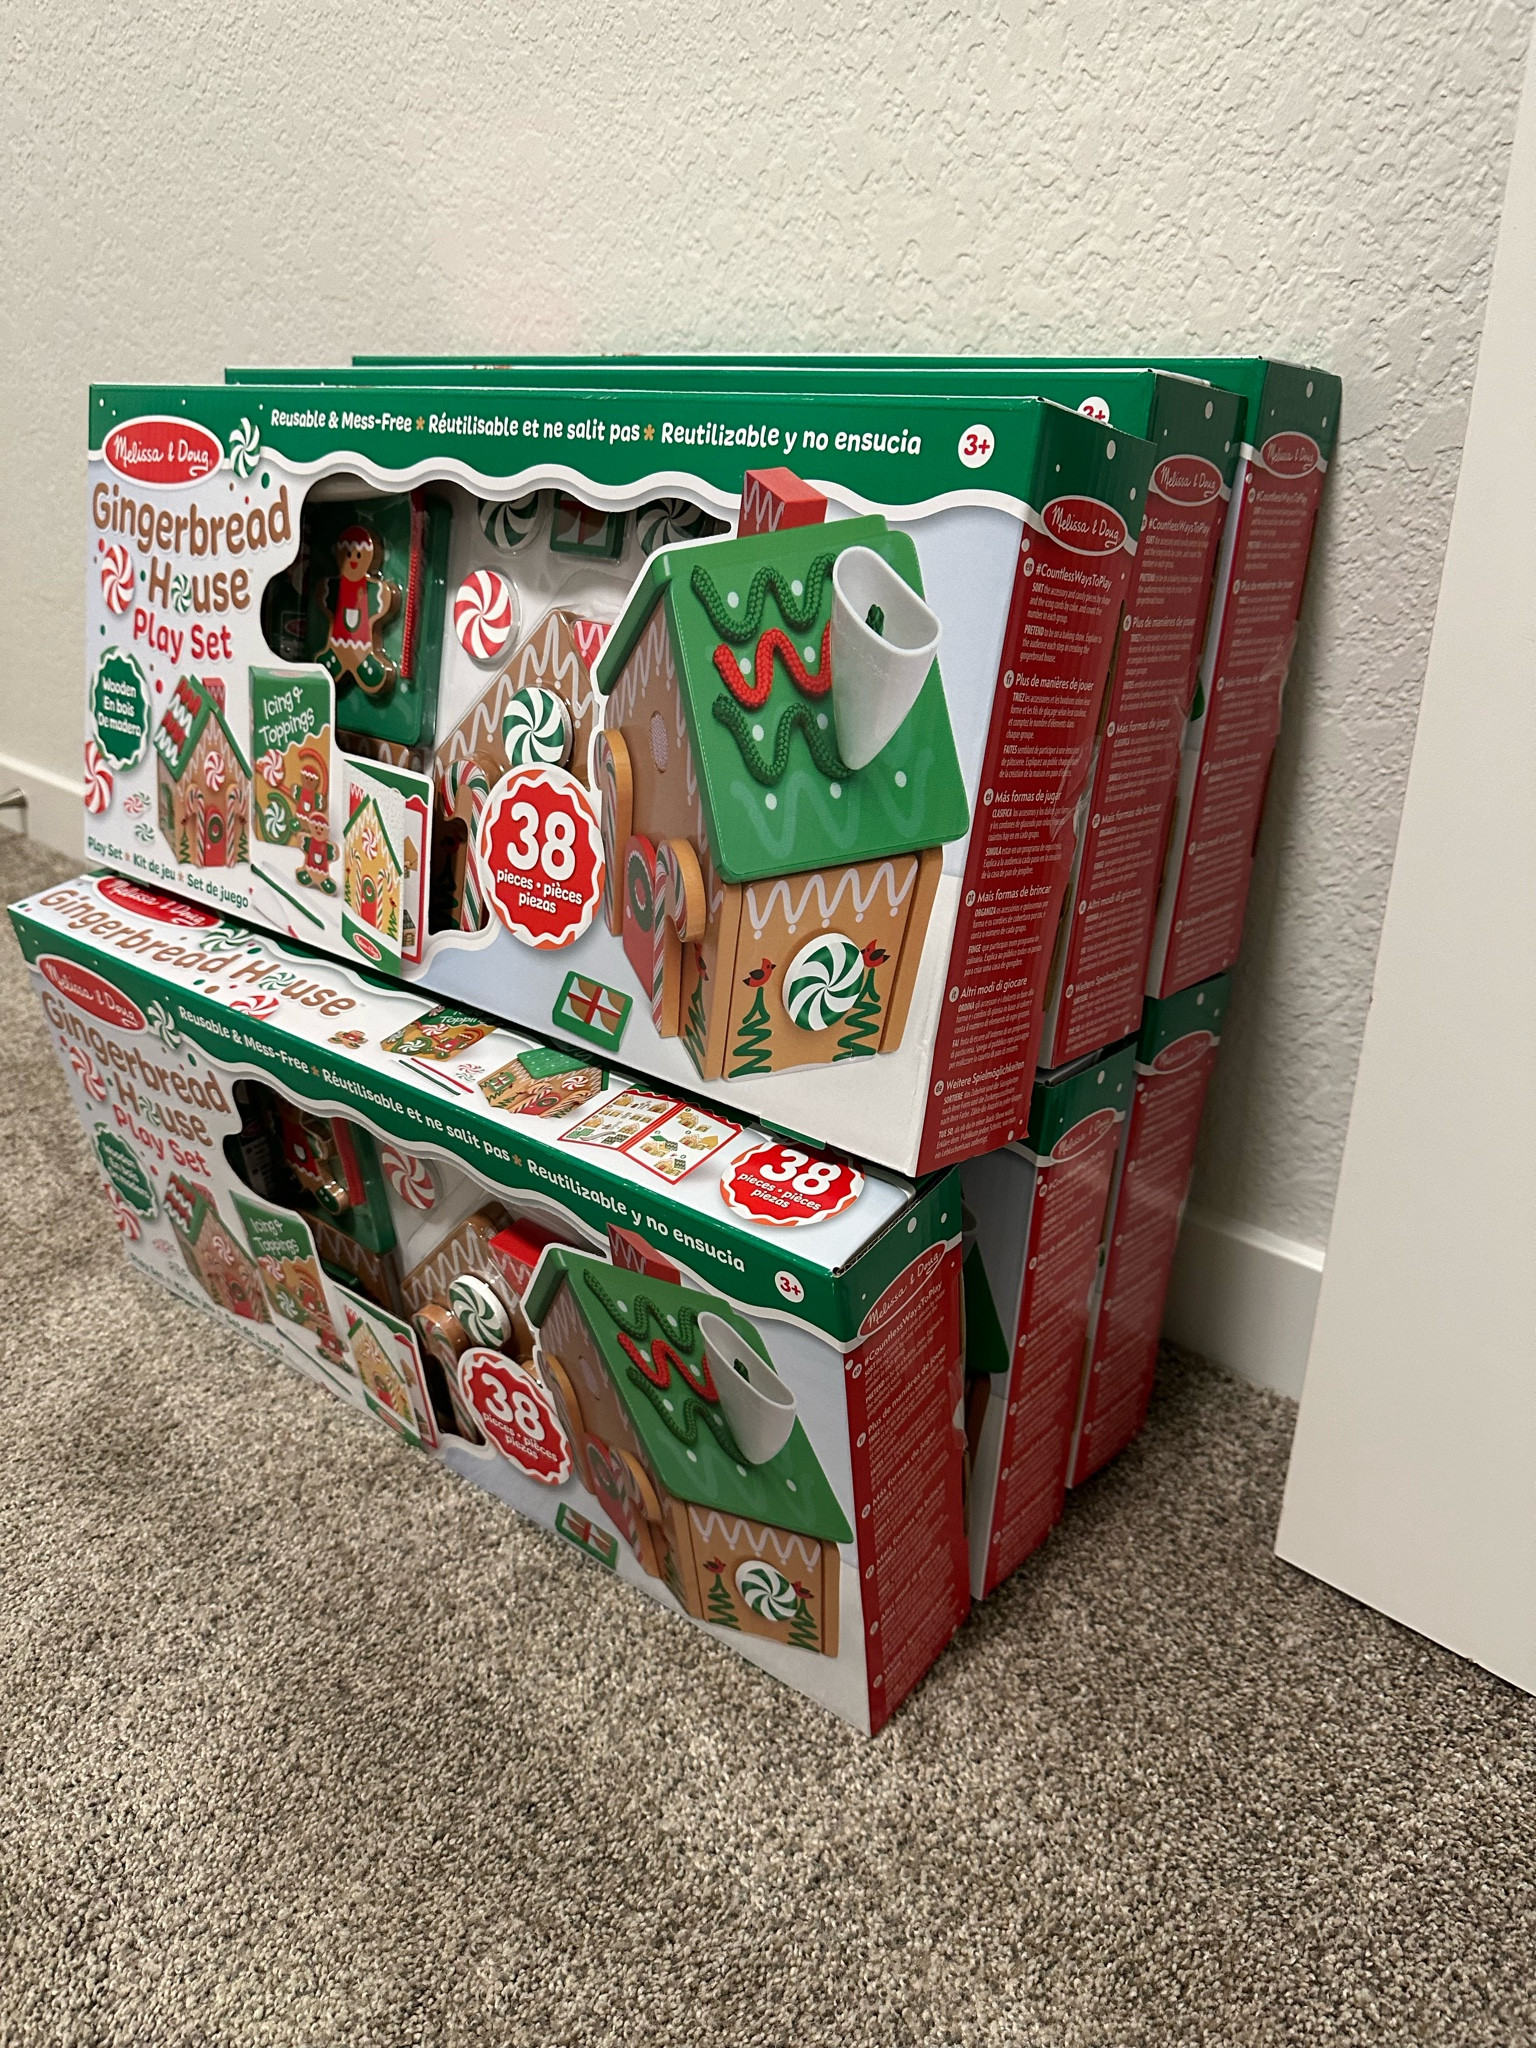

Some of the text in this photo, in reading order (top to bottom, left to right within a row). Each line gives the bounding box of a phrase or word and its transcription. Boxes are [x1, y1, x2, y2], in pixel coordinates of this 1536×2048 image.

[271, 409, 412, 432] Reusable & Mess-Free
[429, 412, 640, 444] Réutilisable et ne salit pas
[660, 422, 921, 454] Reutilizable y no ensucia
[964, 434, 991, 456] 3+
[114, 434, 209, 476] Melissa & Doug
[1161, 466, 1190, 490] Melissa
[93, 482, 291, 556] Gingerbread
[1052, 505, 1089, 533] Melissa
[1099, 519, 1119, 548] Doug
[1032, 582, 1044, 593] SORT
[1036, 563, 1112, 592] #CountlessWaysToPlay
[133, 608, 232, 664] Play Set
[102, 676, 136, 698] Wooden
[1016, 673, 1094, 693] Plus de manières de jouer
[103, 695, 135, 717] En bois
[263, 689, 293, 720] Icing
[98, 712, 141, 737] De madera
[258, 708, 315, 747] Toppings
[995, 789, 1062, 804] Más formas de jugar
[88, 837, 122, 861] Play Set
[506, 802, 576, 881] 38
[133, 854, 175, 881] Kit de jeu
[187, 874, 249, 909] Set de juego
[497, 869, 582, 905] pieces pièces
[519, 893, 556, 913] piezas
[977, 885, 1051, 903] Mais formas de brincar
[39, 889, 241, 974] Gingerbread
[44, 961, 93, 1001] Melissa
[960, 978, 1027, 998] Altri modi di giocare
[42, 991, 231, 1114] Gingerbread
[179, 1005, 309, 1074] Reusable & Mess-Free
[946, 1062, 1024, 1090] Weitere Spielmöglichkeiten
[322, 1068, 510, 1161] Réutilisable et ne salit pas
[112, 1104, 164, 1160] Play
[168, 1139, 211, 1177] Set
[759, 1148, 841, 1195] 38
[737, 1173, 822, 1211] pieces pièces
[751, 1189, 790, 1209] piezas
[251, 1218, 276, 1236] Icing
[527, 1158, 745, 1272] Reutilizable y no ensucia
[254, 1237, 299, 1254] Toppings
[780, 1276, 801, 1295] 3+
[867, 1285, 907, 1328] Melissa
[917, 1253, 939, 1277] Doug
[865, 1281, 942, 1366] #CountlessWaysToPlay
[481, 1373, 545, 1441] 38
[868, 1417, 881, 1435] Plus
[883, 1406, 891, 1418] de
[921, 1363, 929, 1374] de
[483, 1412, 558, 1462] pieces pièces
[506, 1435, 538, 1460] piezas
